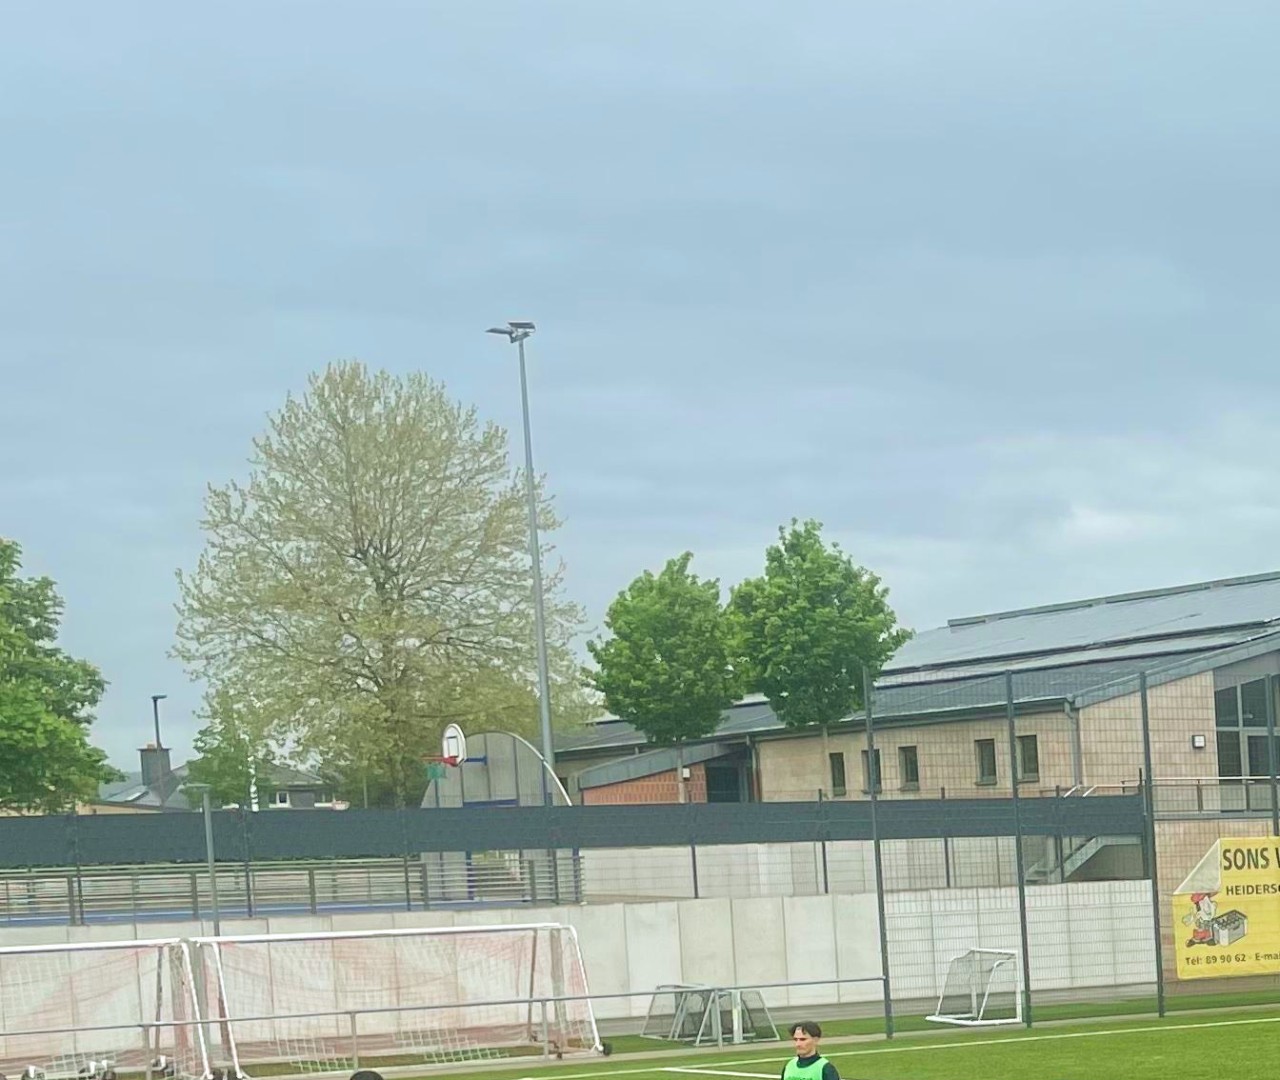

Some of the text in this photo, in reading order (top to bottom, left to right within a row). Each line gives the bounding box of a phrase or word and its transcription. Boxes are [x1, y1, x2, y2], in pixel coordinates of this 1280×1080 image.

[1205, 955, 1218, 965] 89
[1220, 953, 1232, 964] 90
[1234, 952, 1247, 962] 62
